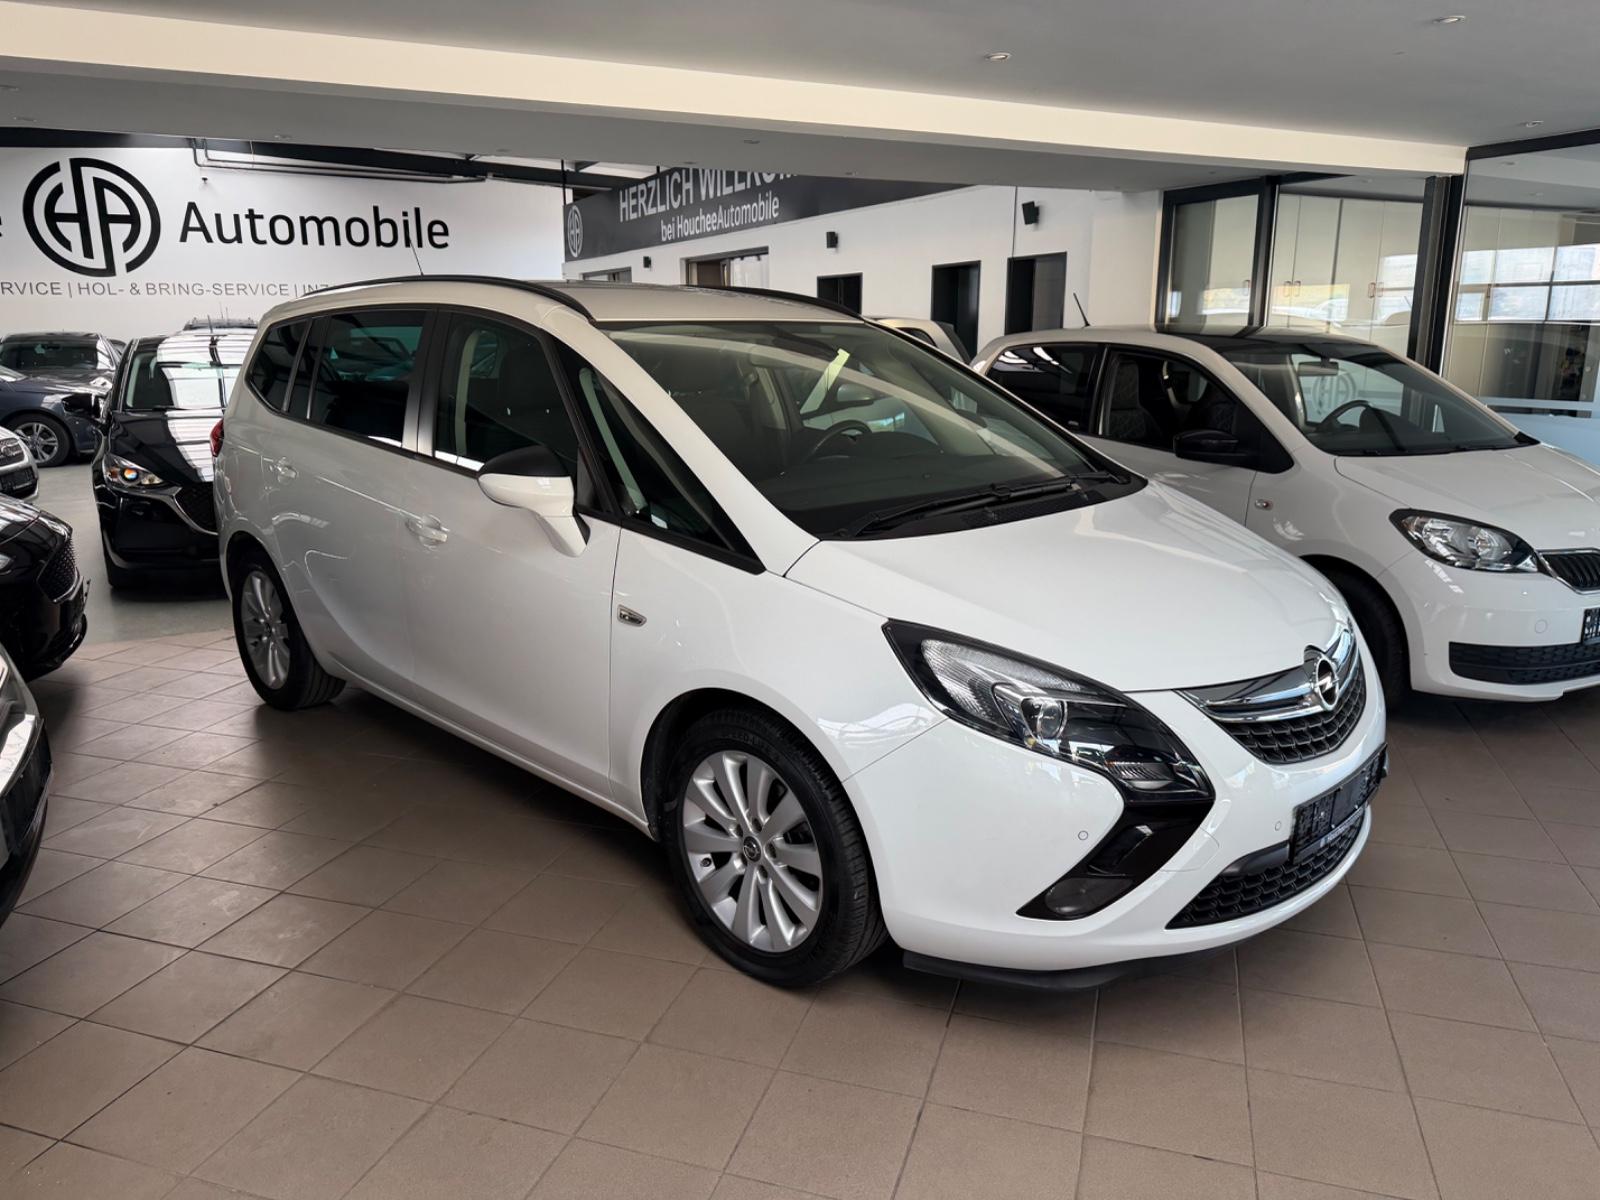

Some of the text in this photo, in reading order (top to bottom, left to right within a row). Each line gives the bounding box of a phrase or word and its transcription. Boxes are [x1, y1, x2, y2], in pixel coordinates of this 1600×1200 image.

[619, 168, 693, 223] HERZLICH
[660, 190, 780, 242] bei HoucheeAutomobile
[179, 201, 450, 249] Automobile
[78, 282, 124, 296] HOL-
[129, 282, 141, 296] &
[145, 282, 290, 297] BRING-SERVICE
